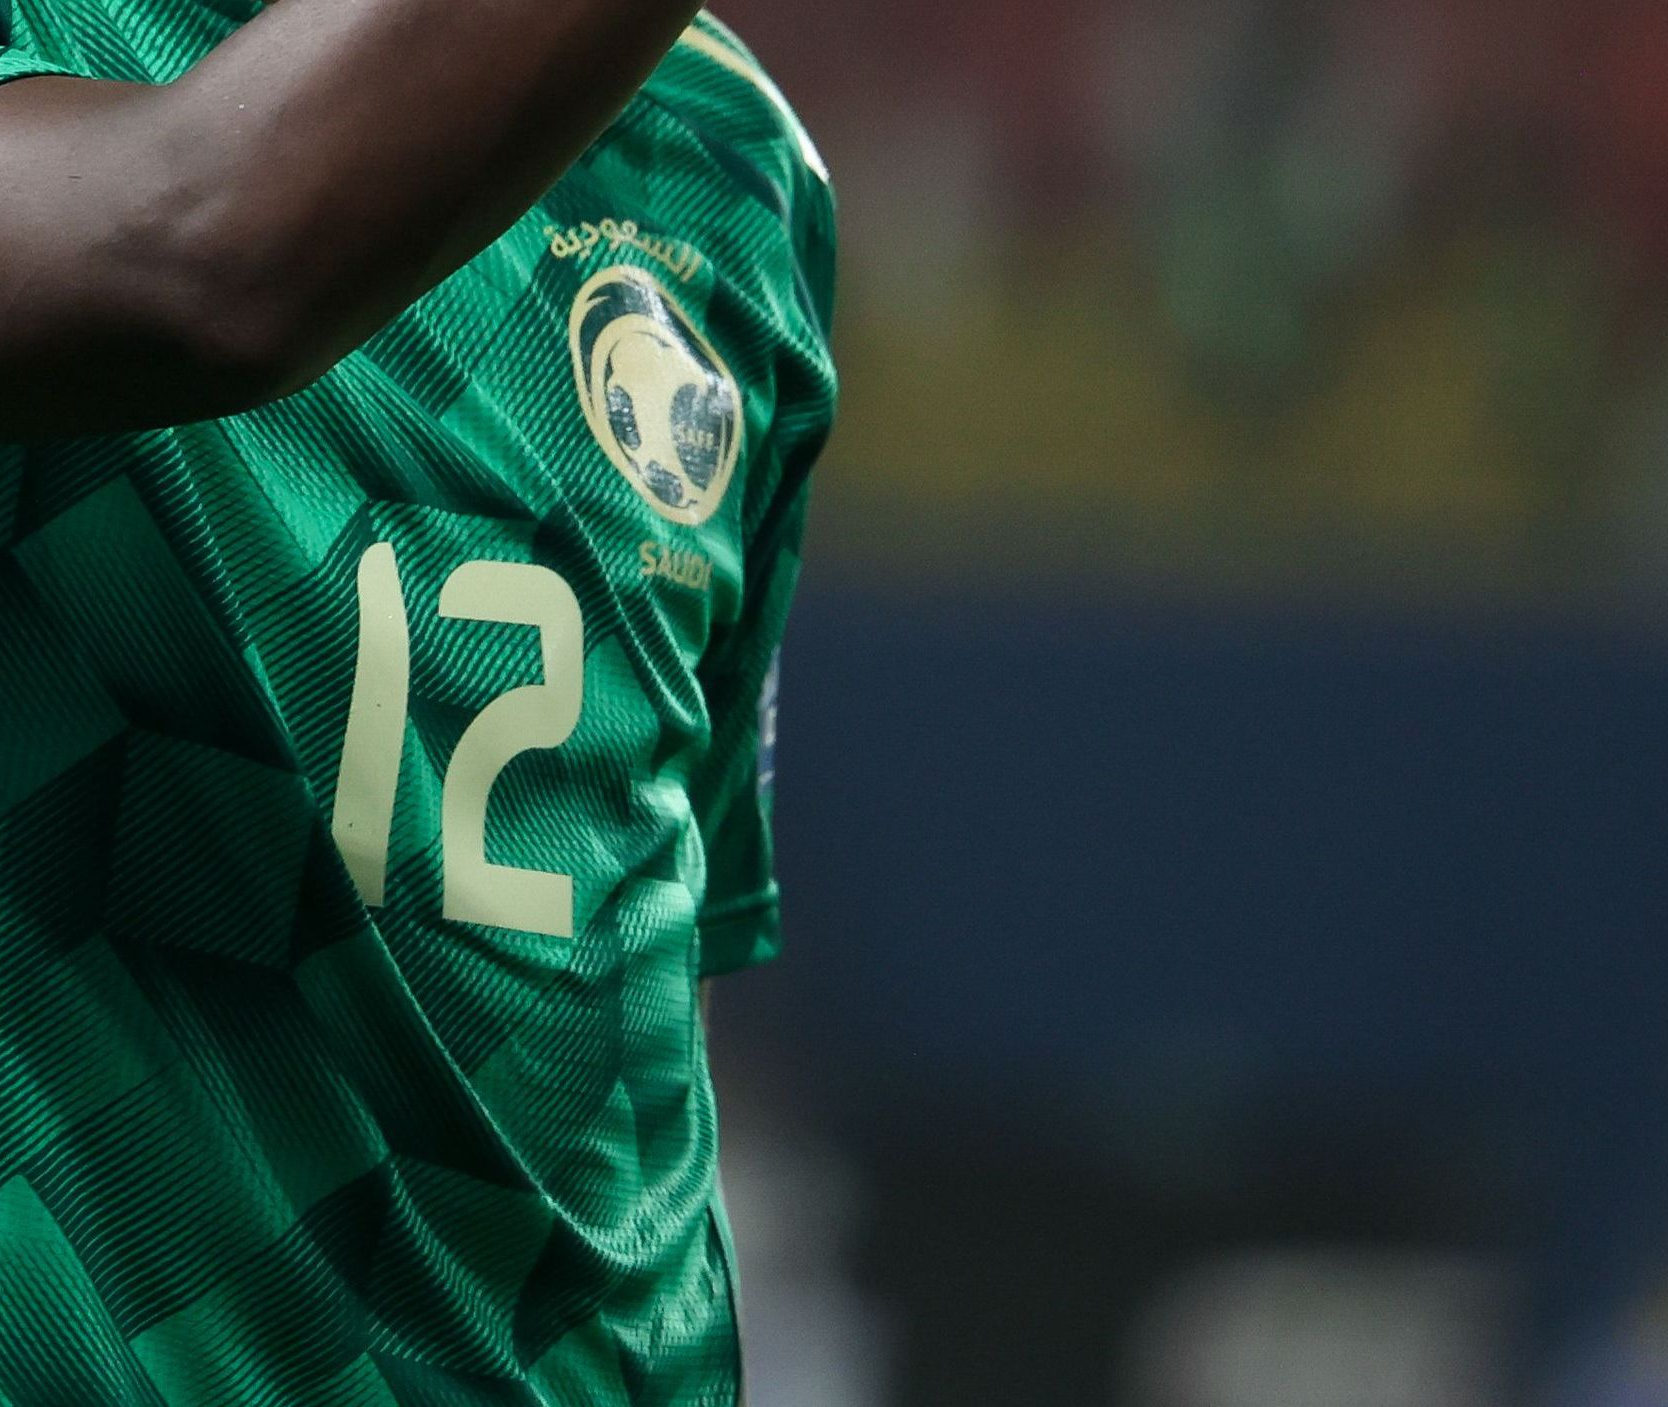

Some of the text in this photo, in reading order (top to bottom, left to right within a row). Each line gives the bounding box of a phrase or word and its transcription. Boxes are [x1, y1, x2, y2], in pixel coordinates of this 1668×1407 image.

[543, 218, 702, 282] السعودية
[639, 542, 713, 591] SAUDI
[332, 542, 583, 937] 12
